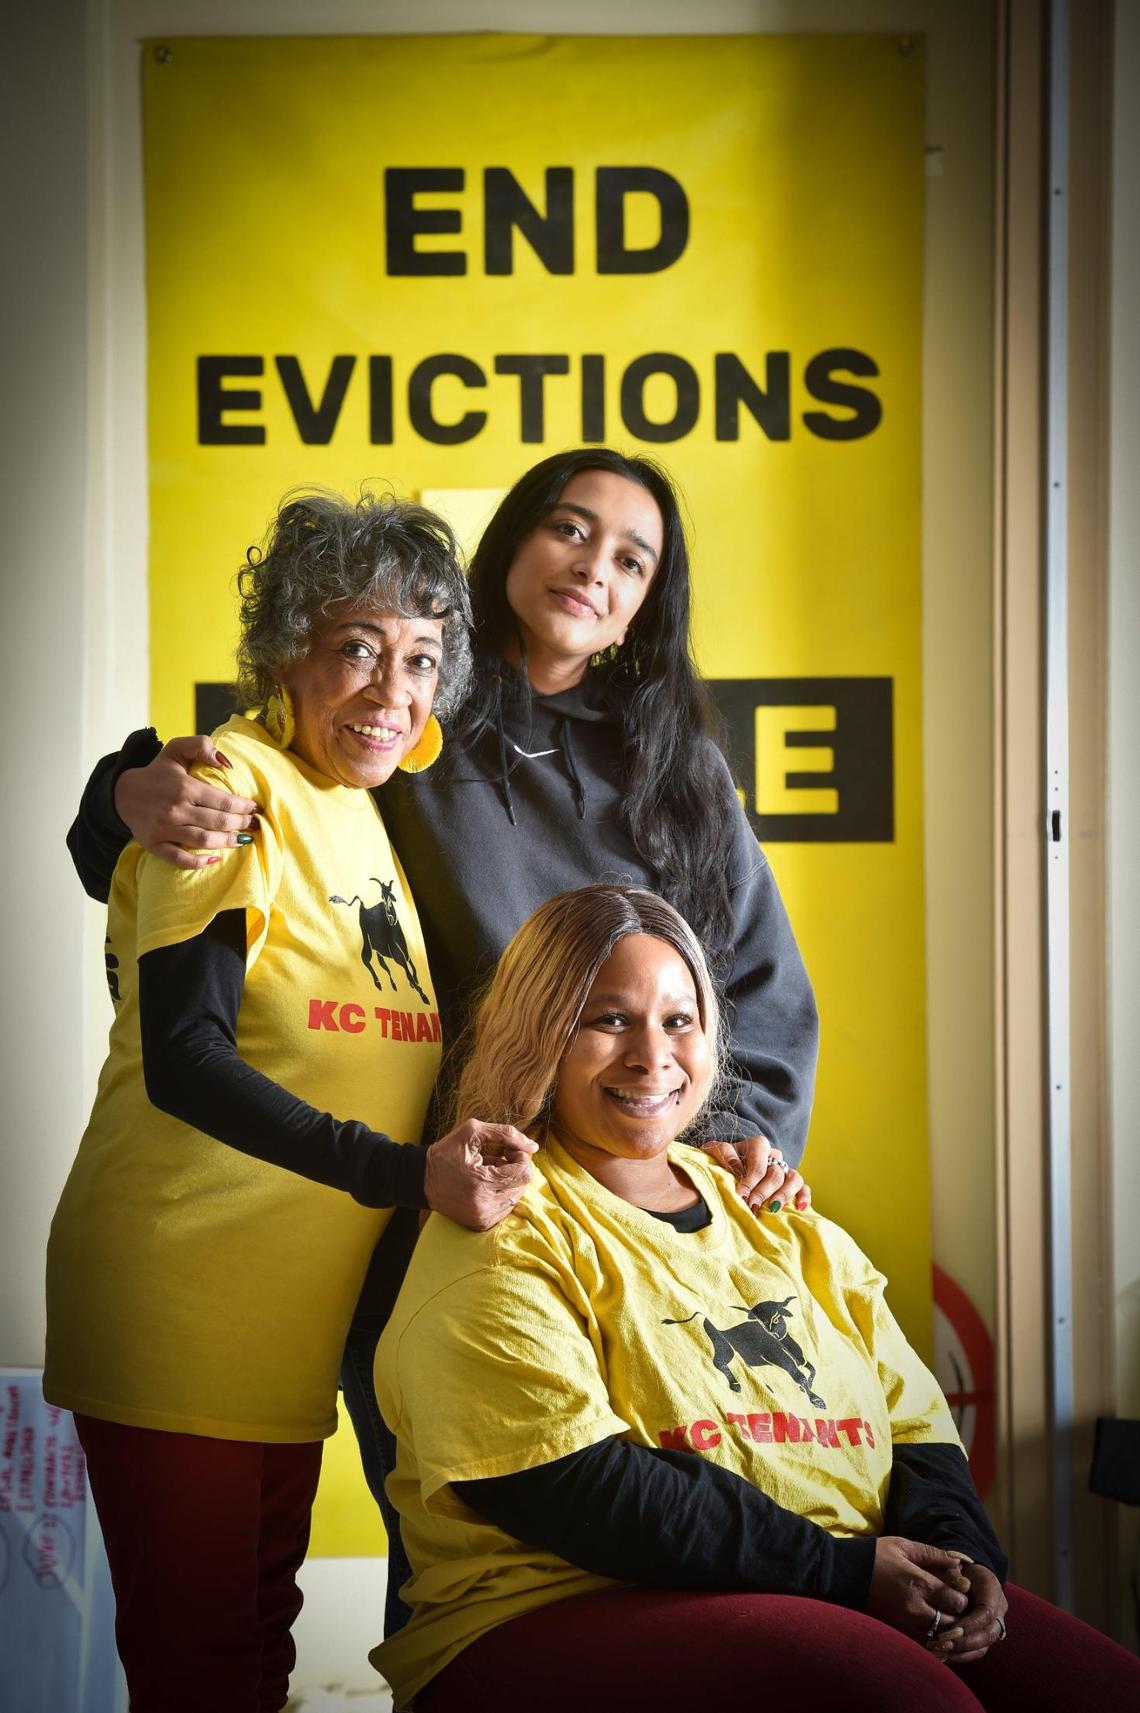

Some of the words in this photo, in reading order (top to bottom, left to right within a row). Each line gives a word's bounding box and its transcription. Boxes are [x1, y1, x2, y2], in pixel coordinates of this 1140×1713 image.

[384, 166, 691, 277] END
[197, 348, 883, 446] EVICTIONS
[308, 999, 366, 1033] KC
[658, 1419, 721, 1454] KC
